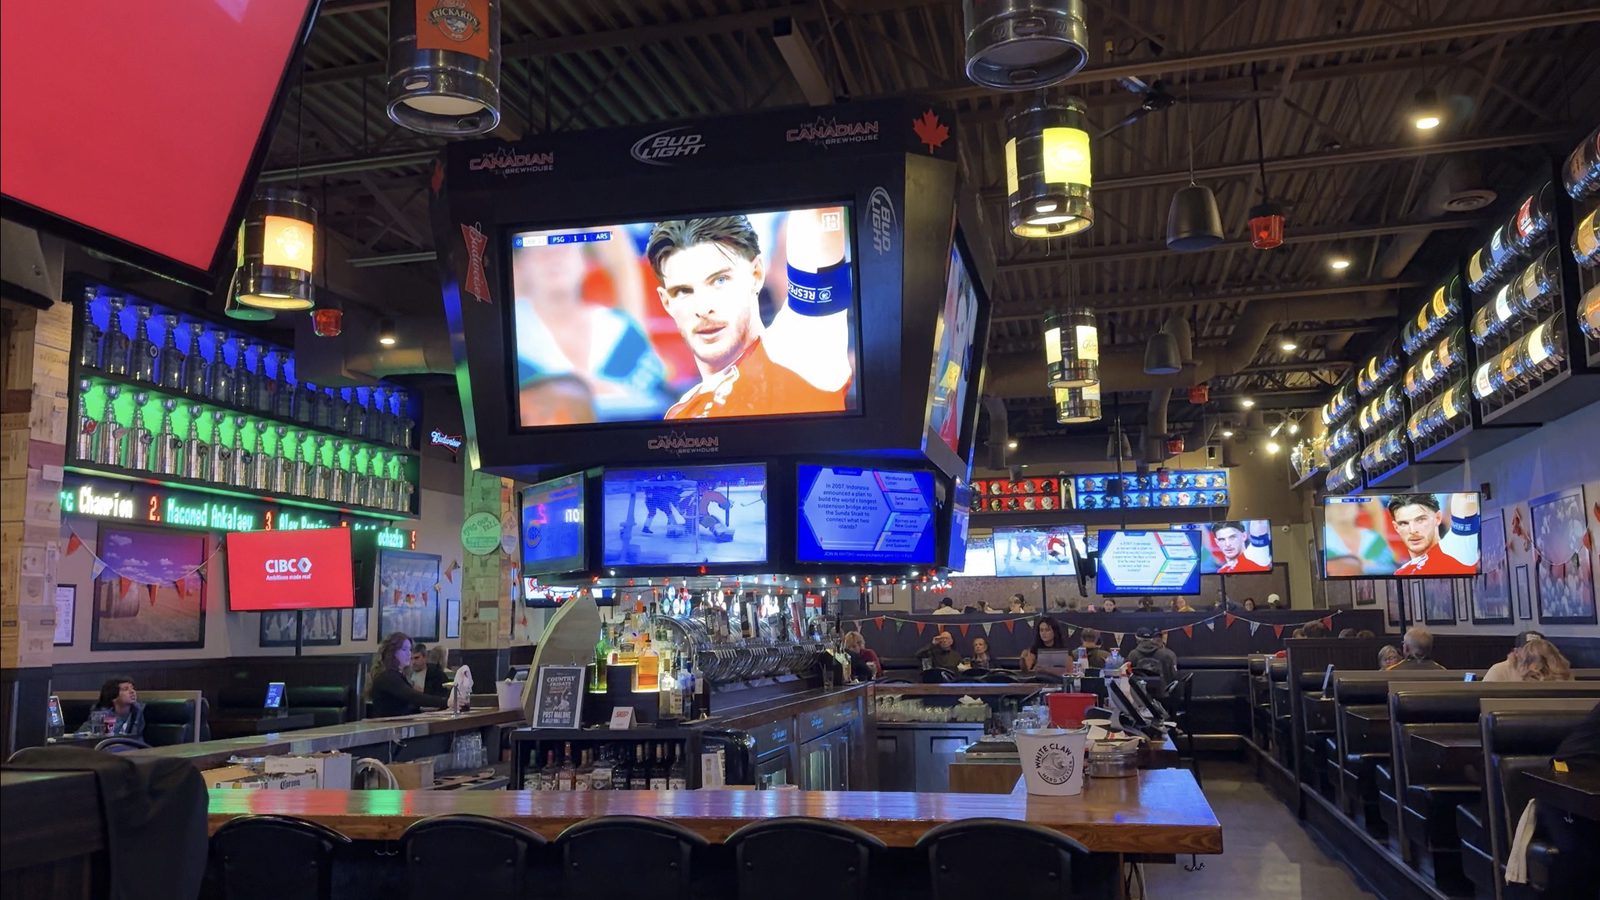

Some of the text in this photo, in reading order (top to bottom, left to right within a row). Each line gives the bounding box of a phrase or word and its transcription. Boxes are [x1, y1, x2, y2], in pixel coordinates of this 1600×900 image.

[432, 7, 478, 26] RICKARD'S
[786, 121, 879, 142] CANADIAN
[825, 134, 879, 145] BREWHOUSE
[652, 134, 702, 148] BUD
[640, 143, 706, 159] LIGHT
[469, 151, 554, 171] CANADIAN
[505, 165, 554, 174] BREWHOUSE
[871, 195, 883, 256] LIGHT
[881, 206, 891, 252] BUD
[552, 235, 565, 243] PSG
[647, 436, 719, 450] CANADIAN
[79, 485, 134, 518] Champion
[149, 496, 161, 521] 2.
[265, 558, 297, 574] CIBC
[542, 711, 571, 719] POST MALONE
[1034, 743, 1072, 769] WHITE CLAW
[280, 778, 301, 790] Corona
